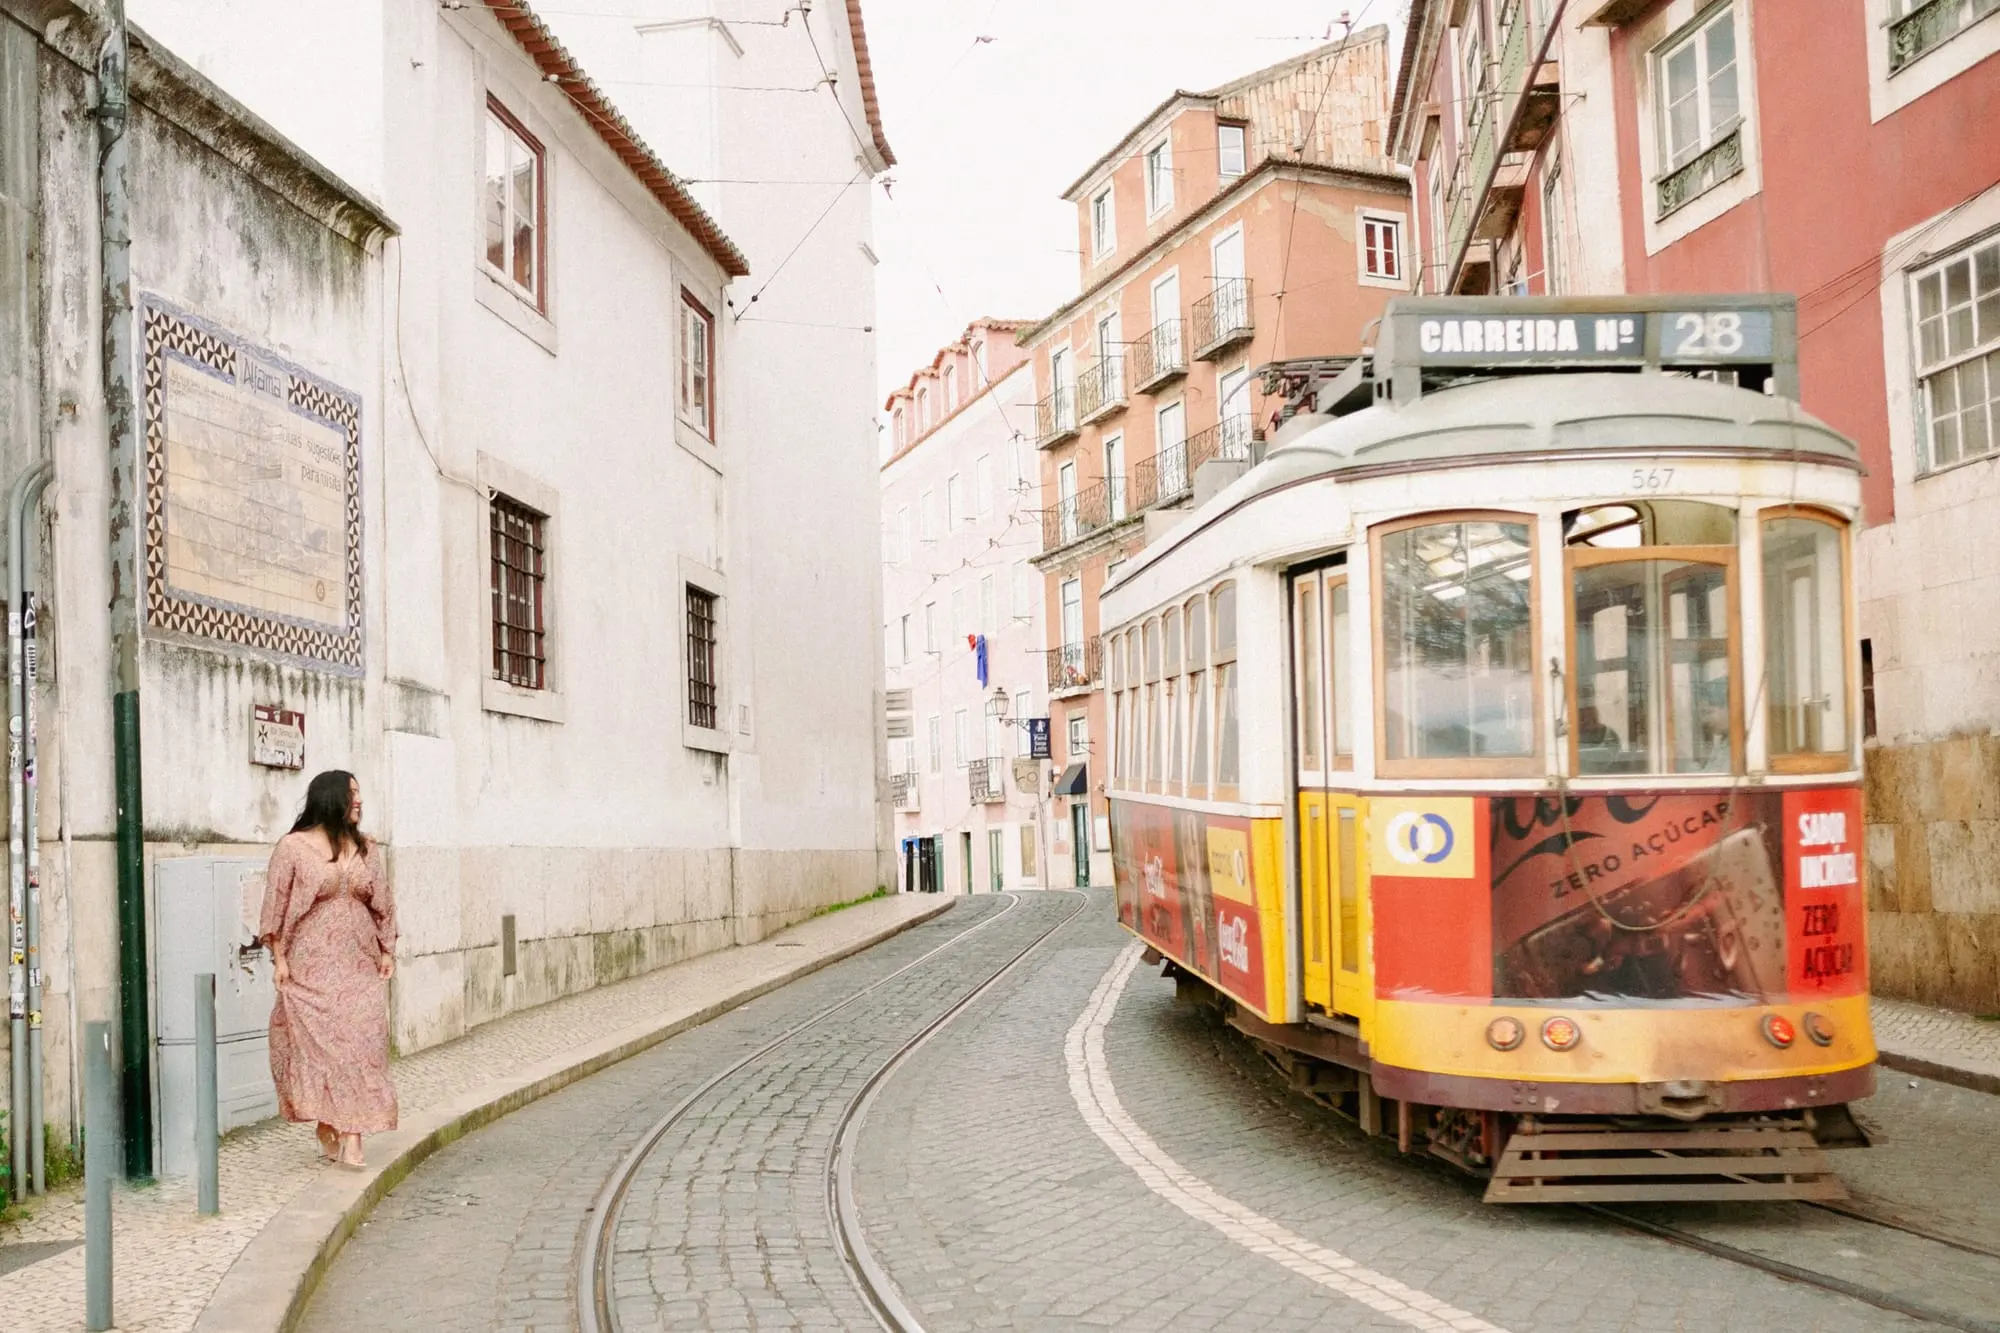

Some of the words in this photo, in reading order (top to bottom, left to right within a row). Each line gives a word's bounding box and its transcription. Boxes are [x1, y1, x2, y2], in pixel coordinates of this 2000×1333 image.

[1420, 319, 1579, 353] CARREIRA
[1595, 319, 1634, 352] Nº
[1675, 311, 1744, 356] 28
[243, 357, 281, 398] Alfama
[1631, 468, 1675, 489] 567
[1549, 854, 1621, 898] ZERO
[1631, 801, 1731, 861] AÇÚCAR
